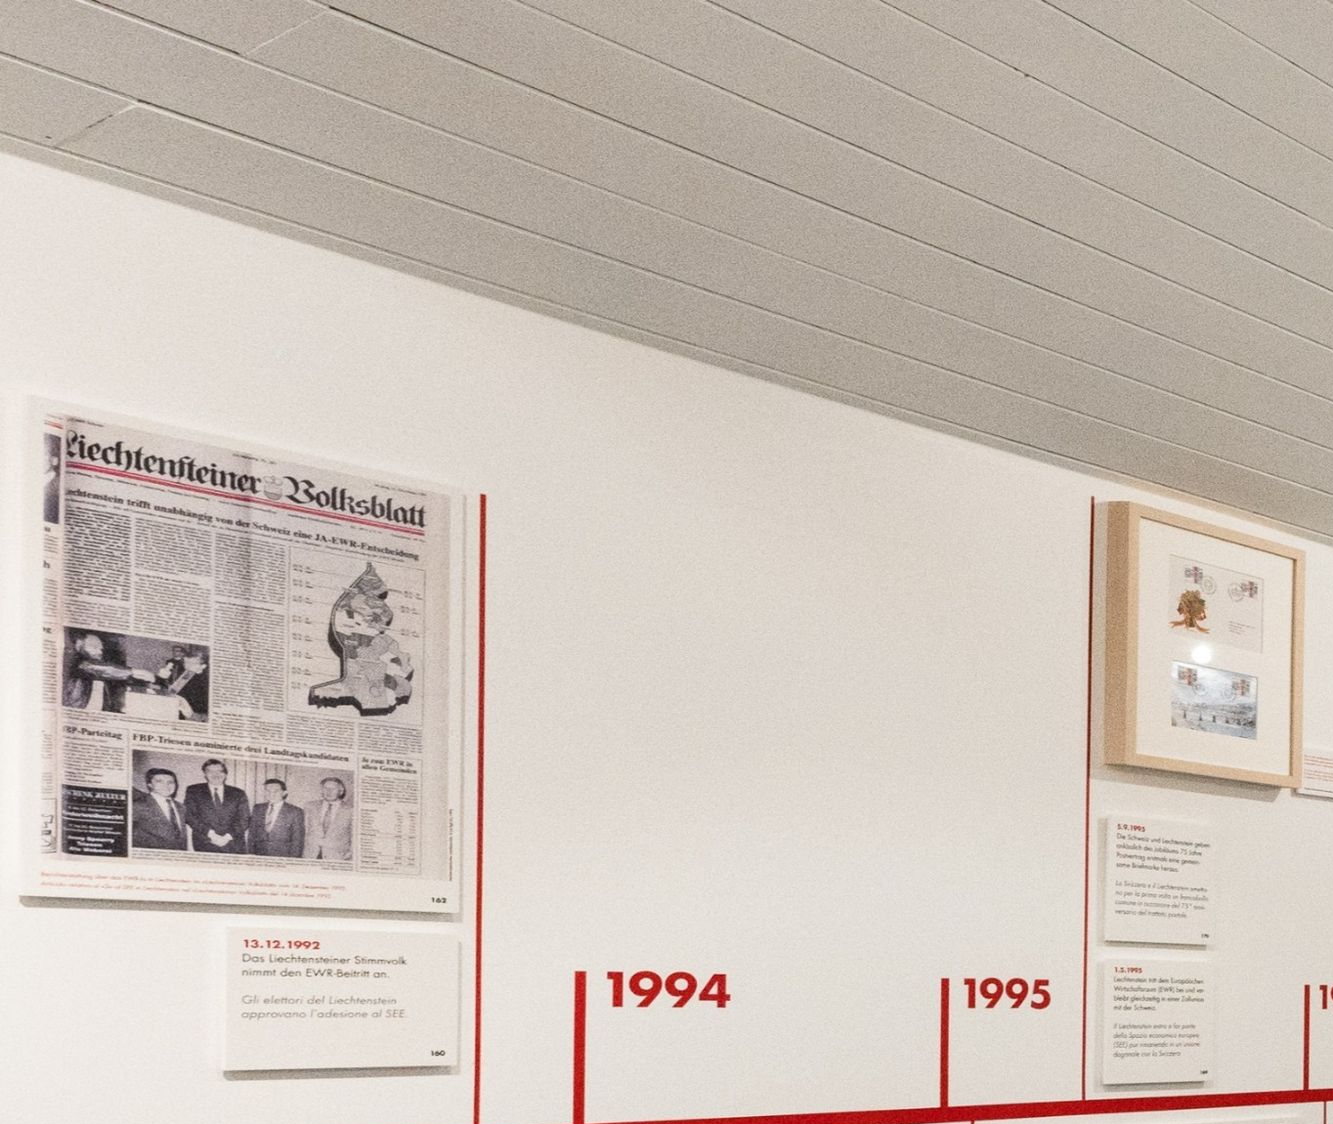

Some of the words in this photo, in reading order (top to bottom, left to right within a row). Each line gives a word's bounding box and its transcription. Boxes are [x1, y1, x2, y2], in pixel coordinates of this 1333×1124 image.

[282, 475, 427, 529] Volksblatt
[243, 939, 320, 950] 13.12.1992
[242, 954, 265, 963] Das
[269, 955, 350, 965] Liechtensteiner
[354, 955, 407, 965] Stimmvolk
[241, 968, 276, 977] nimmt
[280, 968, 301, 977] den
[306, 969, 370, 978] EWR-Beitritt
[607, 970, 732, 1009] 1994
[963, 976, 1052, 1010] 1995
[241, 995, 260, 1005] Gli
[263, 996, 303, 1005] elettori
[307, 996, 325, 1005] del
[329, 996, 397, 1005] Liechtenstein
[241, 1011, 307, 1020] approvano
[371, 1009, 382, 1018] al
